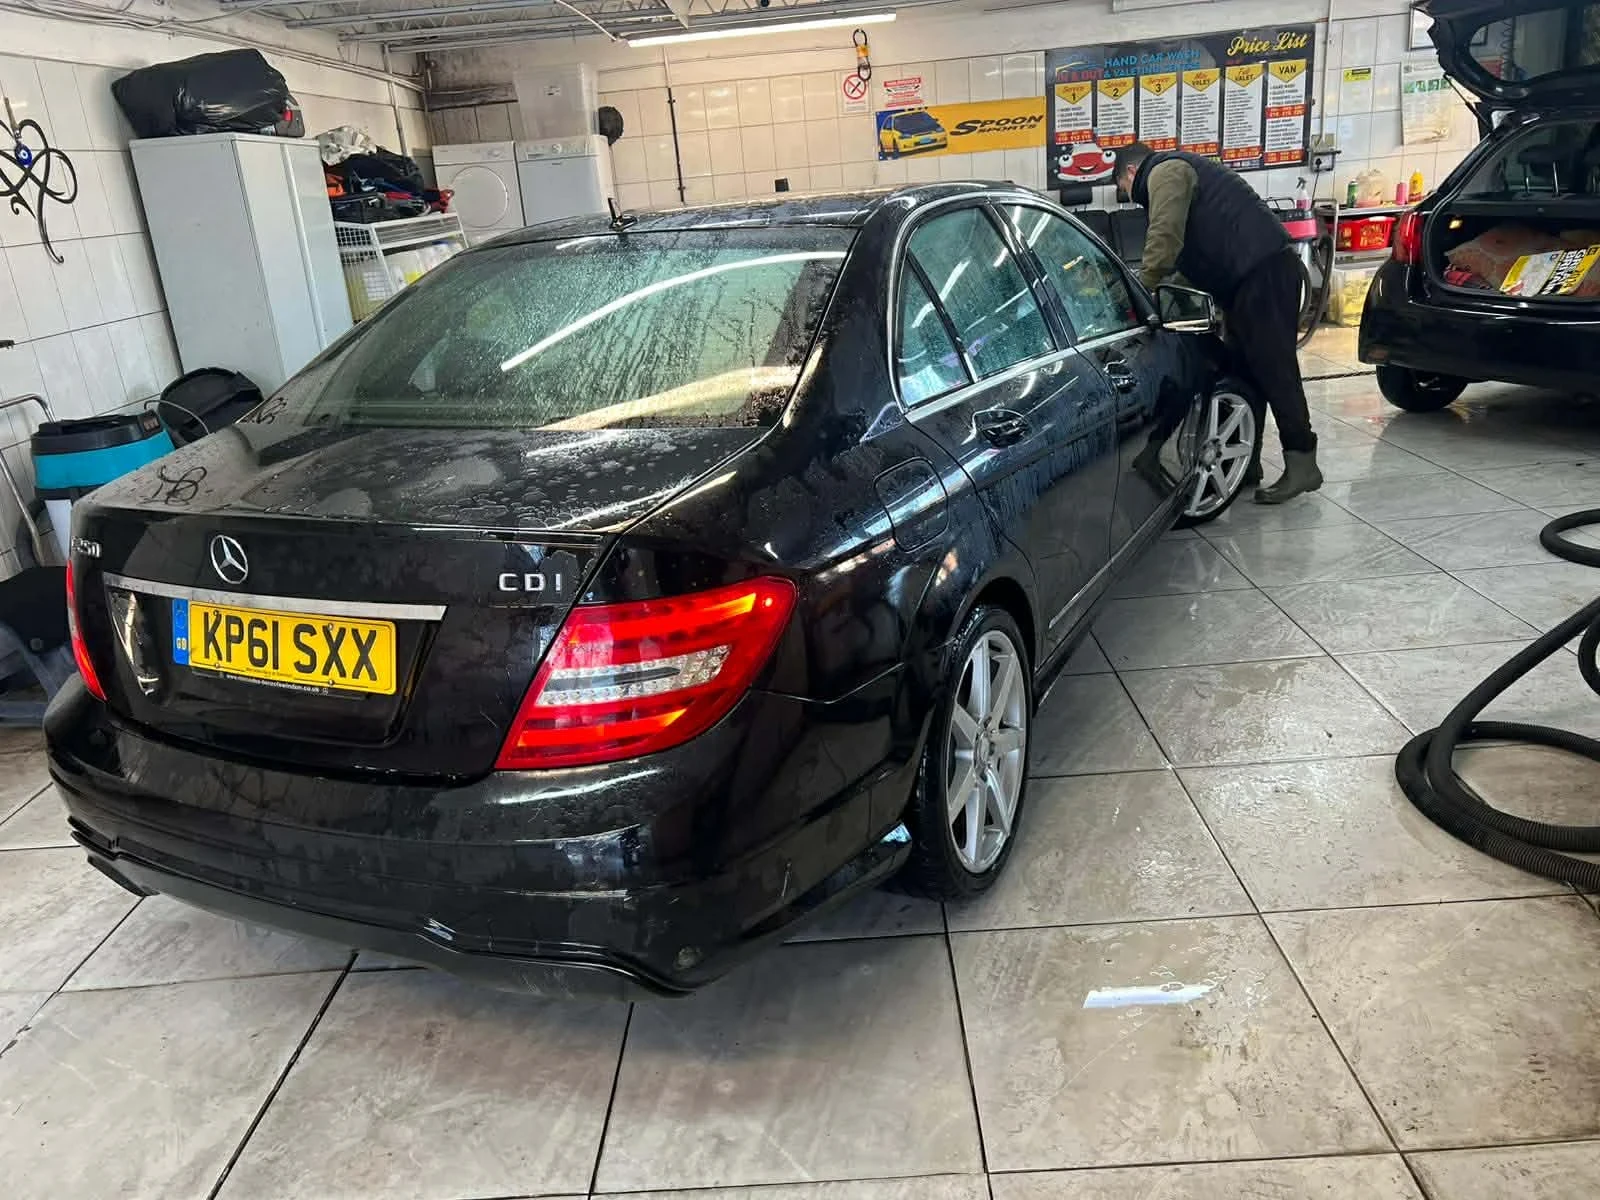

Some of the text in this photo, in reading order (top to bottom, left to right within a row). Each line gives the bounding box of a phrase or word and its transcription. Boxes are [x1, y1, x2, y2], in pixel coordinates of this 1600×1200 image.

[1227, 32, 1308, 56] Price List
[1104, 47, 1201, 68] HAND CAR WASH
[1279, 64, 1297, 75] VAN
[1112, 87, 1120, 98] 2
[1155, 83, 1162, 94] 3
[1072, 92, 1076, 102] 1
[950, 114, 1044, 136] SPOON
[977, 124, 1037, 133] SPORTS
[499, 573, 561, 591] CDI
[203, 611, 378, 682] KP61 SXX
